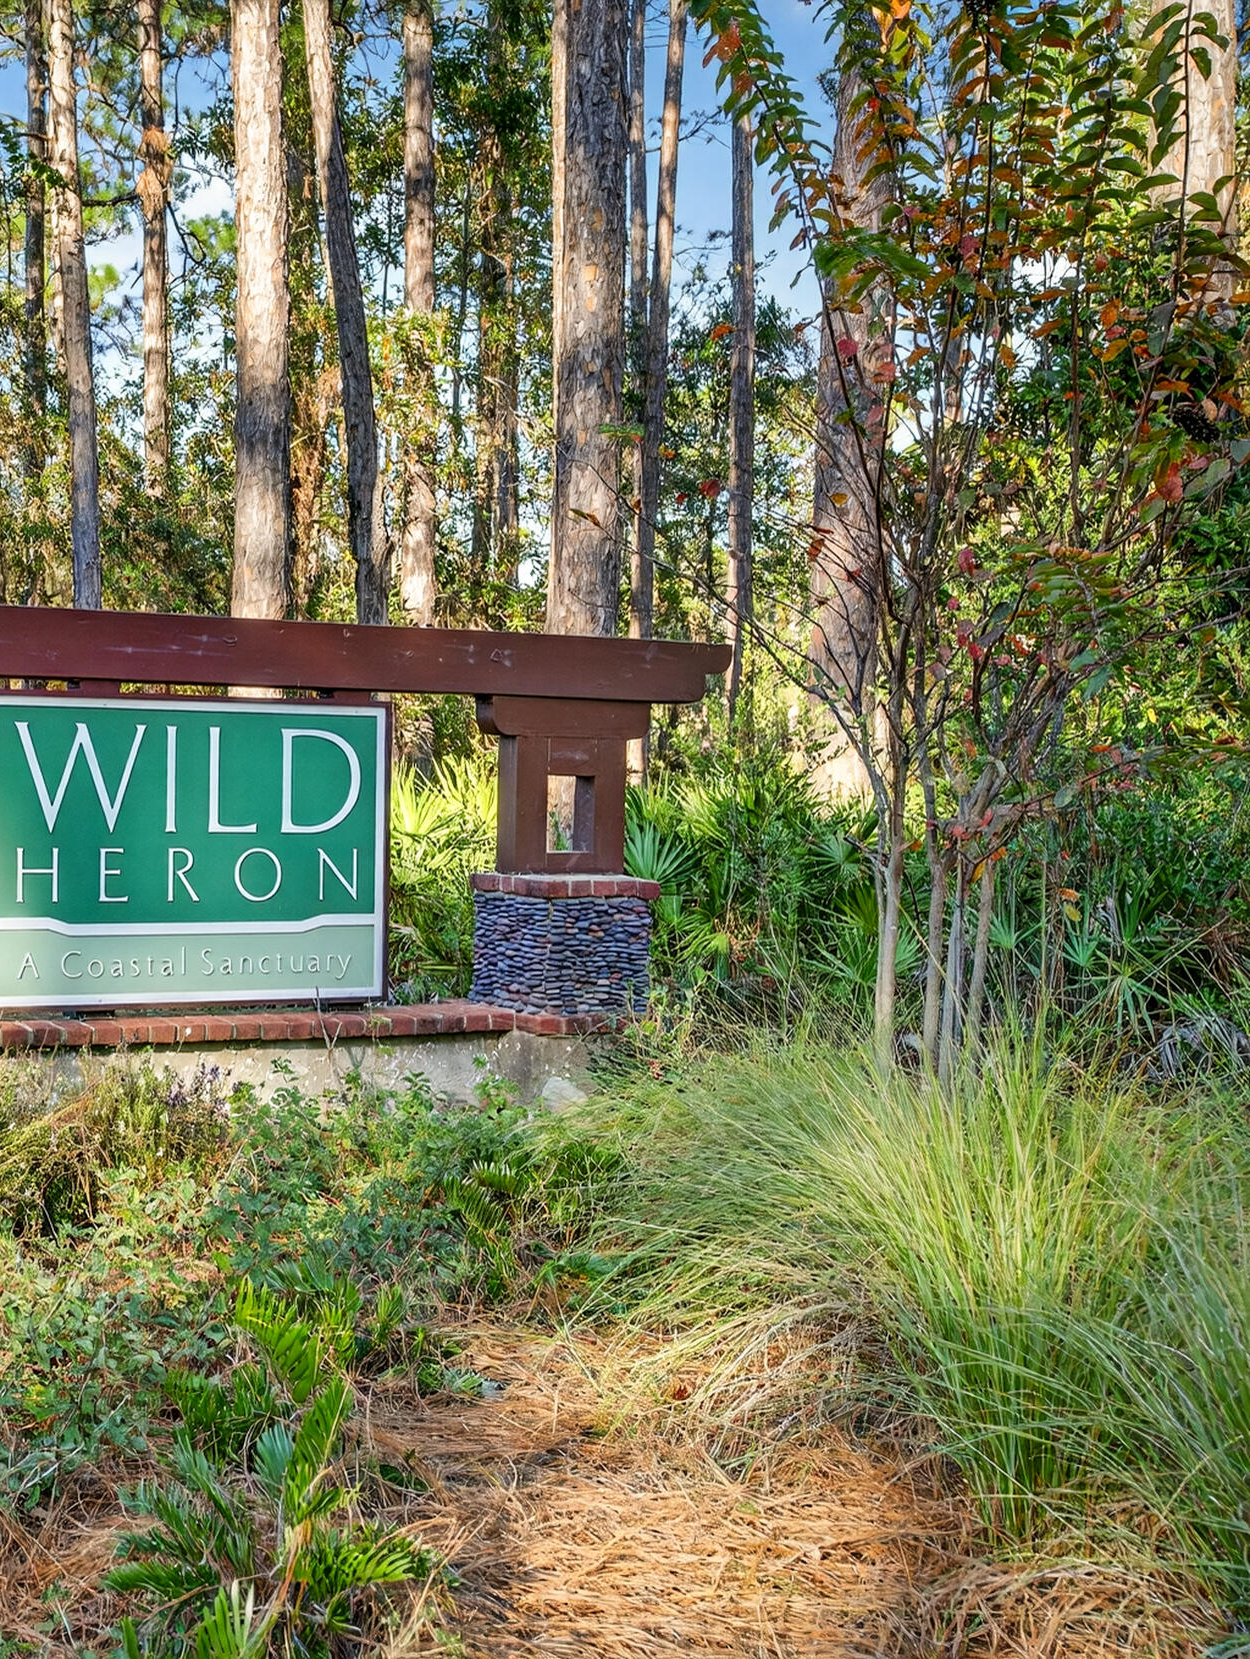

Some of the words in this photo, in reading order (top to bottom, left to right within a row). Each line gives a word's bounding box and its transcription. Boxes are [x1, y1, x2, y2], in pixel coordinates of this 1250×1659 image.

[14, 720, 362, 834] WILD
[16, 847, 358, 903] HERON
[17, 952, 40, 980] A
[61, 946, 188, 979] Coastal
[200, 947, 353, 979] Sanctuary
